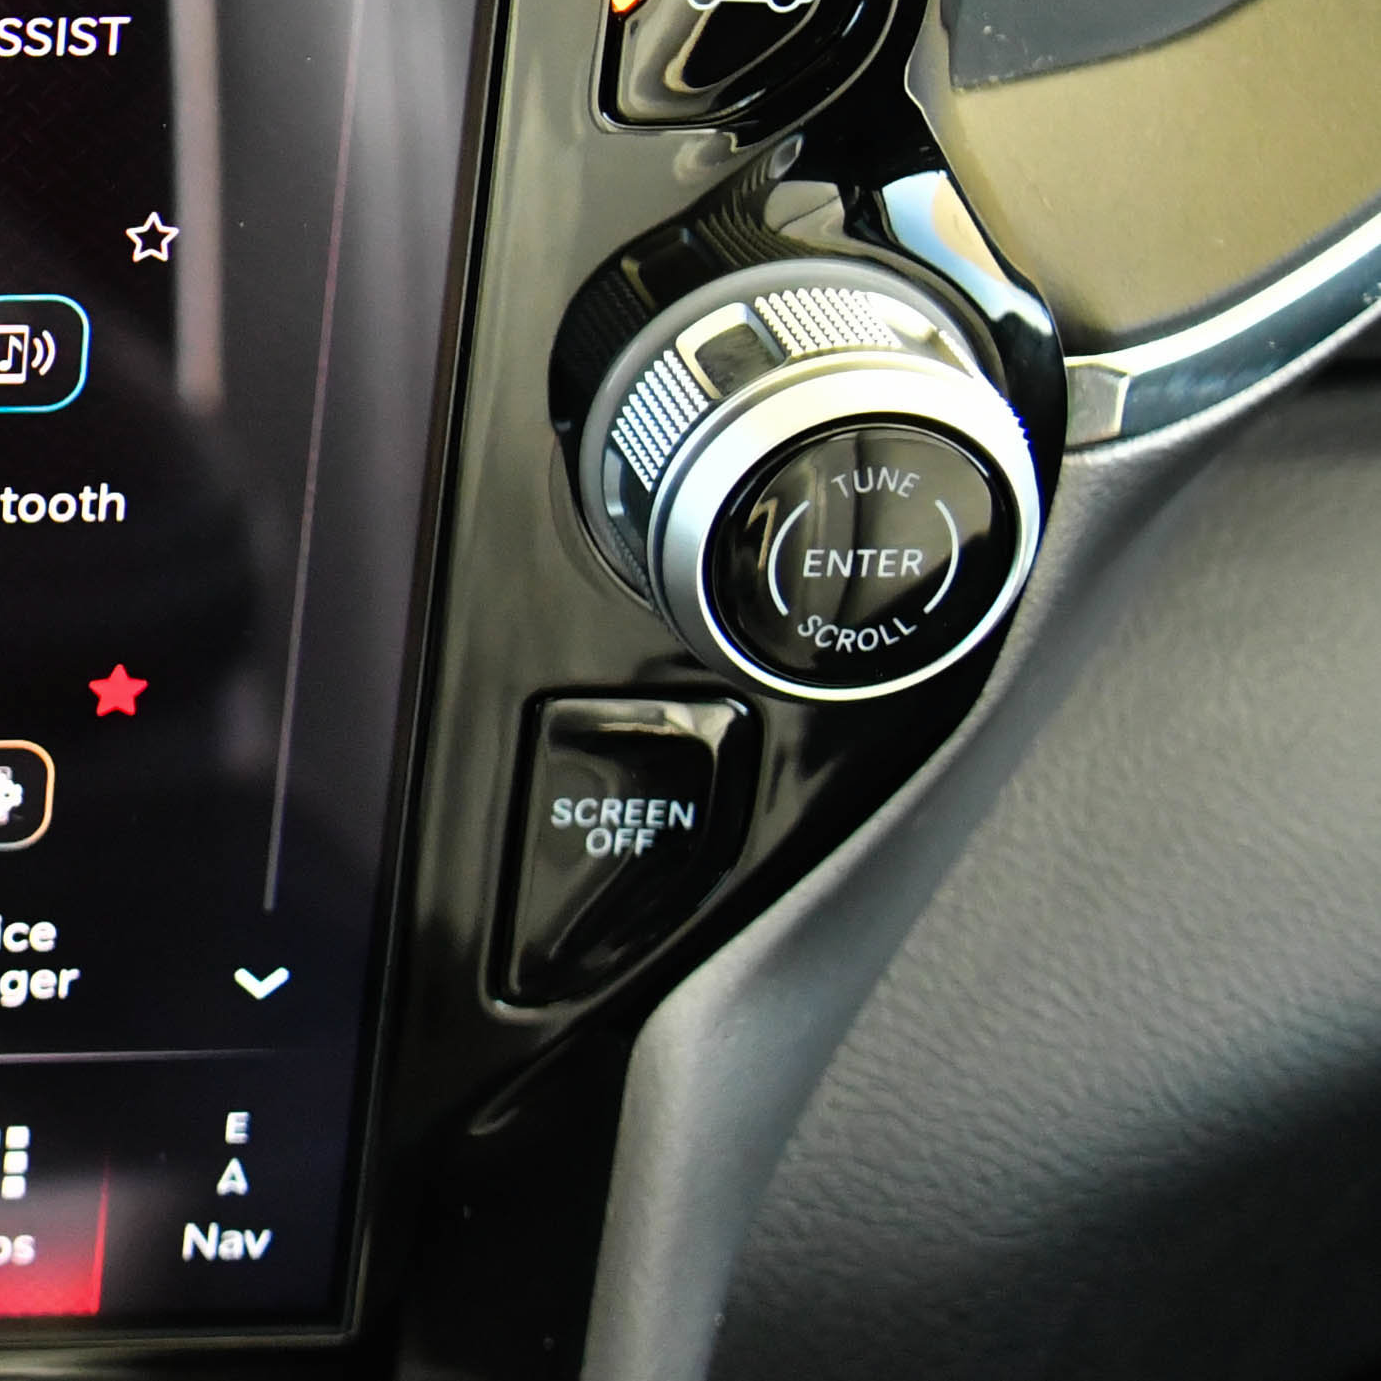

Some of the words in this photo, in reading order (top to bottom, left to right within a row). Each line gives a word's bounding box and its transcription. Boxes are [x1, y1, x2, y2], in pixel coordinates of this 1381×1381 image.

[829, 465, 922, 499] TUNE
[801, 546, 929, 579] ENTER
[795, 613, 919, 654] SCROLL
[549, 797, 695, 832] SCREEN
[584, 826, 657, 859] OFF
[224, 1110, 251, 1145] E
[181, 1221, 272, 1261] Nav
